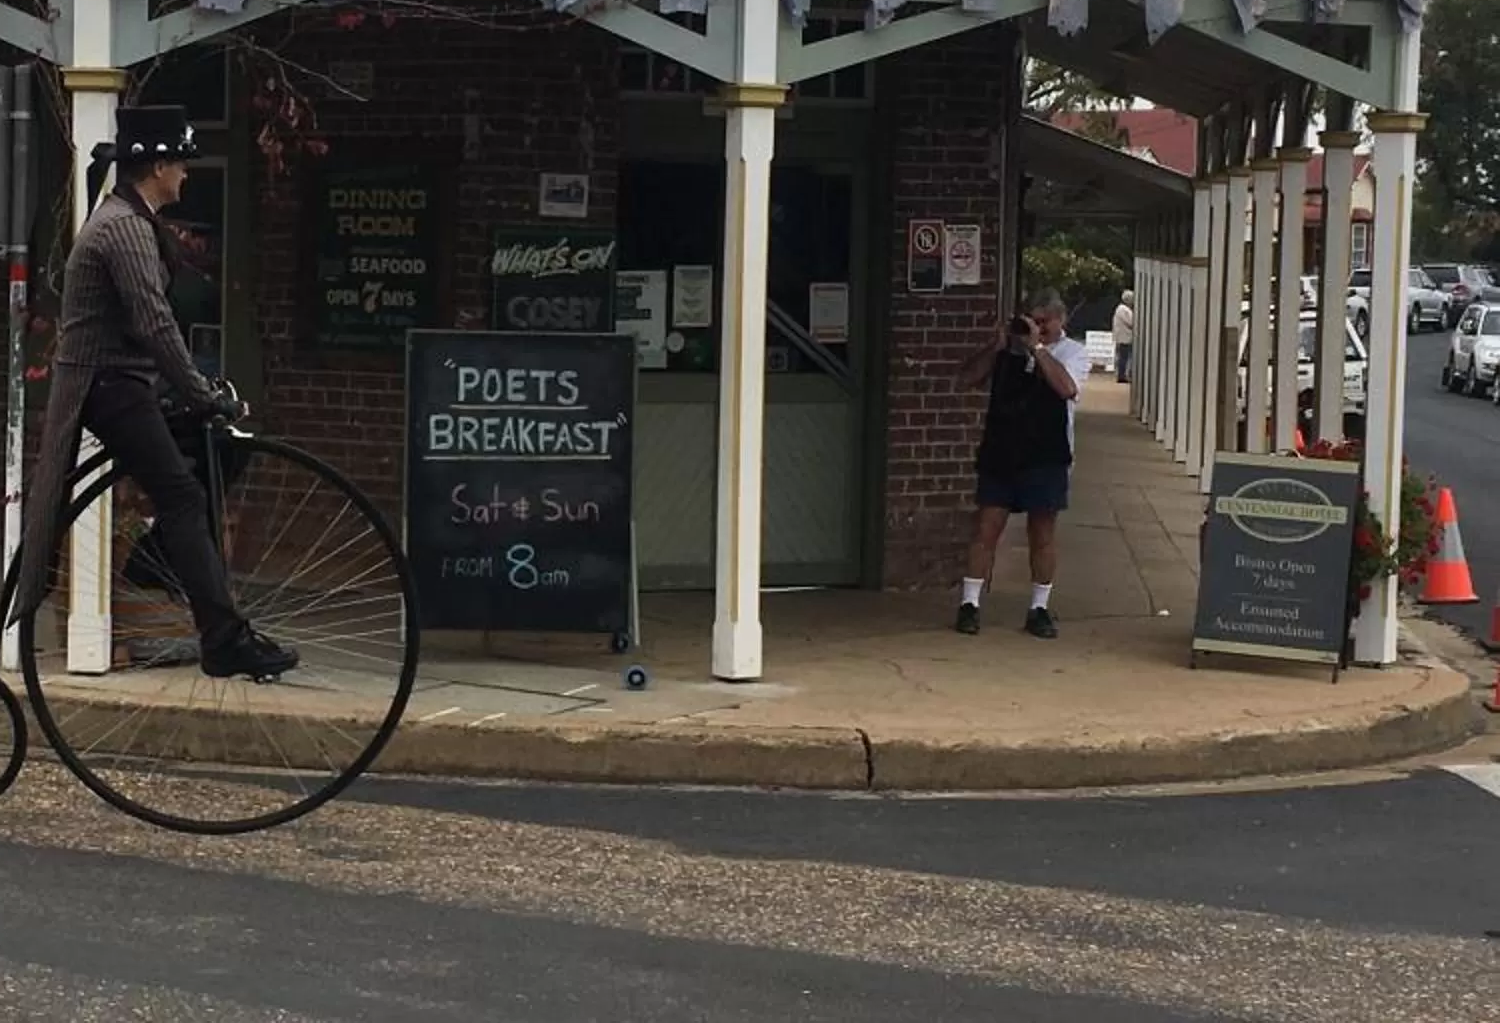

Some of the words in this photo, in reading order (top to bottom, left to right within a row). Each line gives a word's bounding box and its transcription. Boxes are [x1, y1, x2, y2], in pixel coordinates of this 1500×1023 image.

[328, 188, 427, 210] DINING
[336, 214, 417, 237] ROOM
[348, 256, 427, 275] SEAFOOD
[491, 237, 571, 277] WHAT'S
[570, 240, 616, 271] ON
[327, 288, 360, 307] OPEN
[360, 280, 385, 314] 7
[381, 289, 418, 307] DAYS
[507, 295, 603, 329] COSEY
[451, 483, 508, 525] Sat
[541, 487, 600, 523] Sun
[1279, 559, 1316, 576] Open
